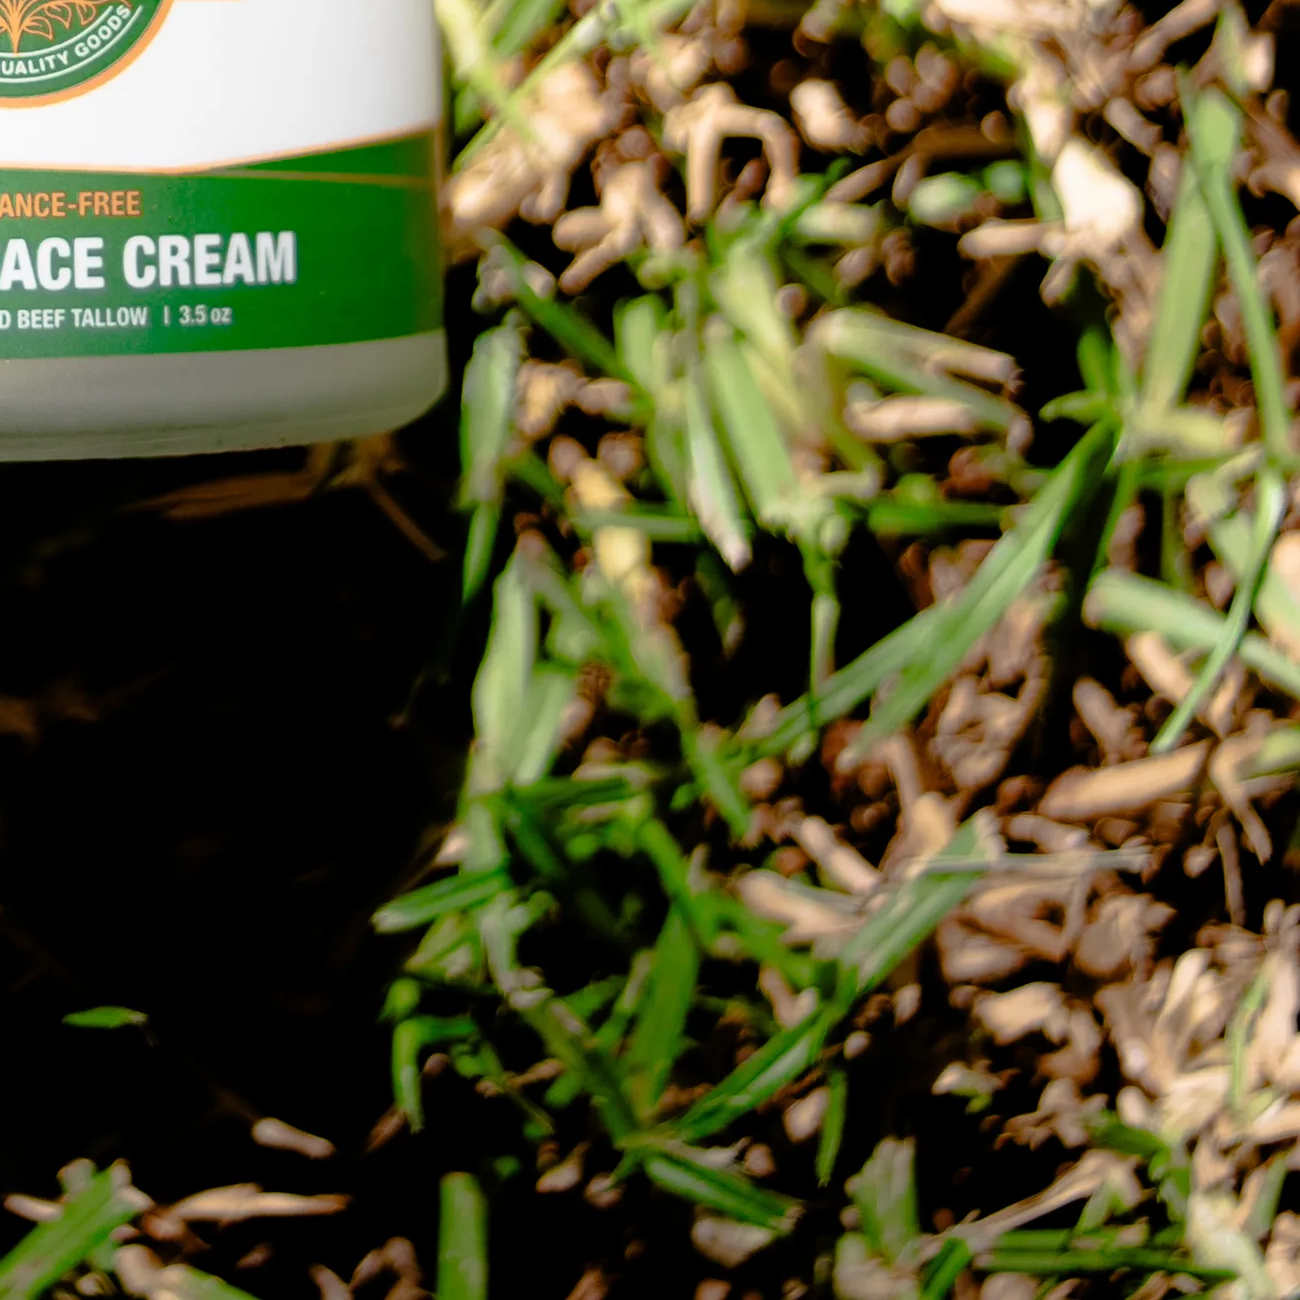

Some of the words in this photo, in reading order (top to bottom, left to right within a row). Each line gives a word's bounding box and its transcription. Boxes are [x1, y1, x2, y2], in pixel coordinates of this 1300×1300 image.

[74, 4, 131, 57] GOODS
[123, 230, 297, 289] CREAM
[17, 308, 66, 330] BEEF
[71, 306, 149, 328] TALLOW
[179, 305, 206, 326] 3.5
[211, 307, 232, 325] oz
